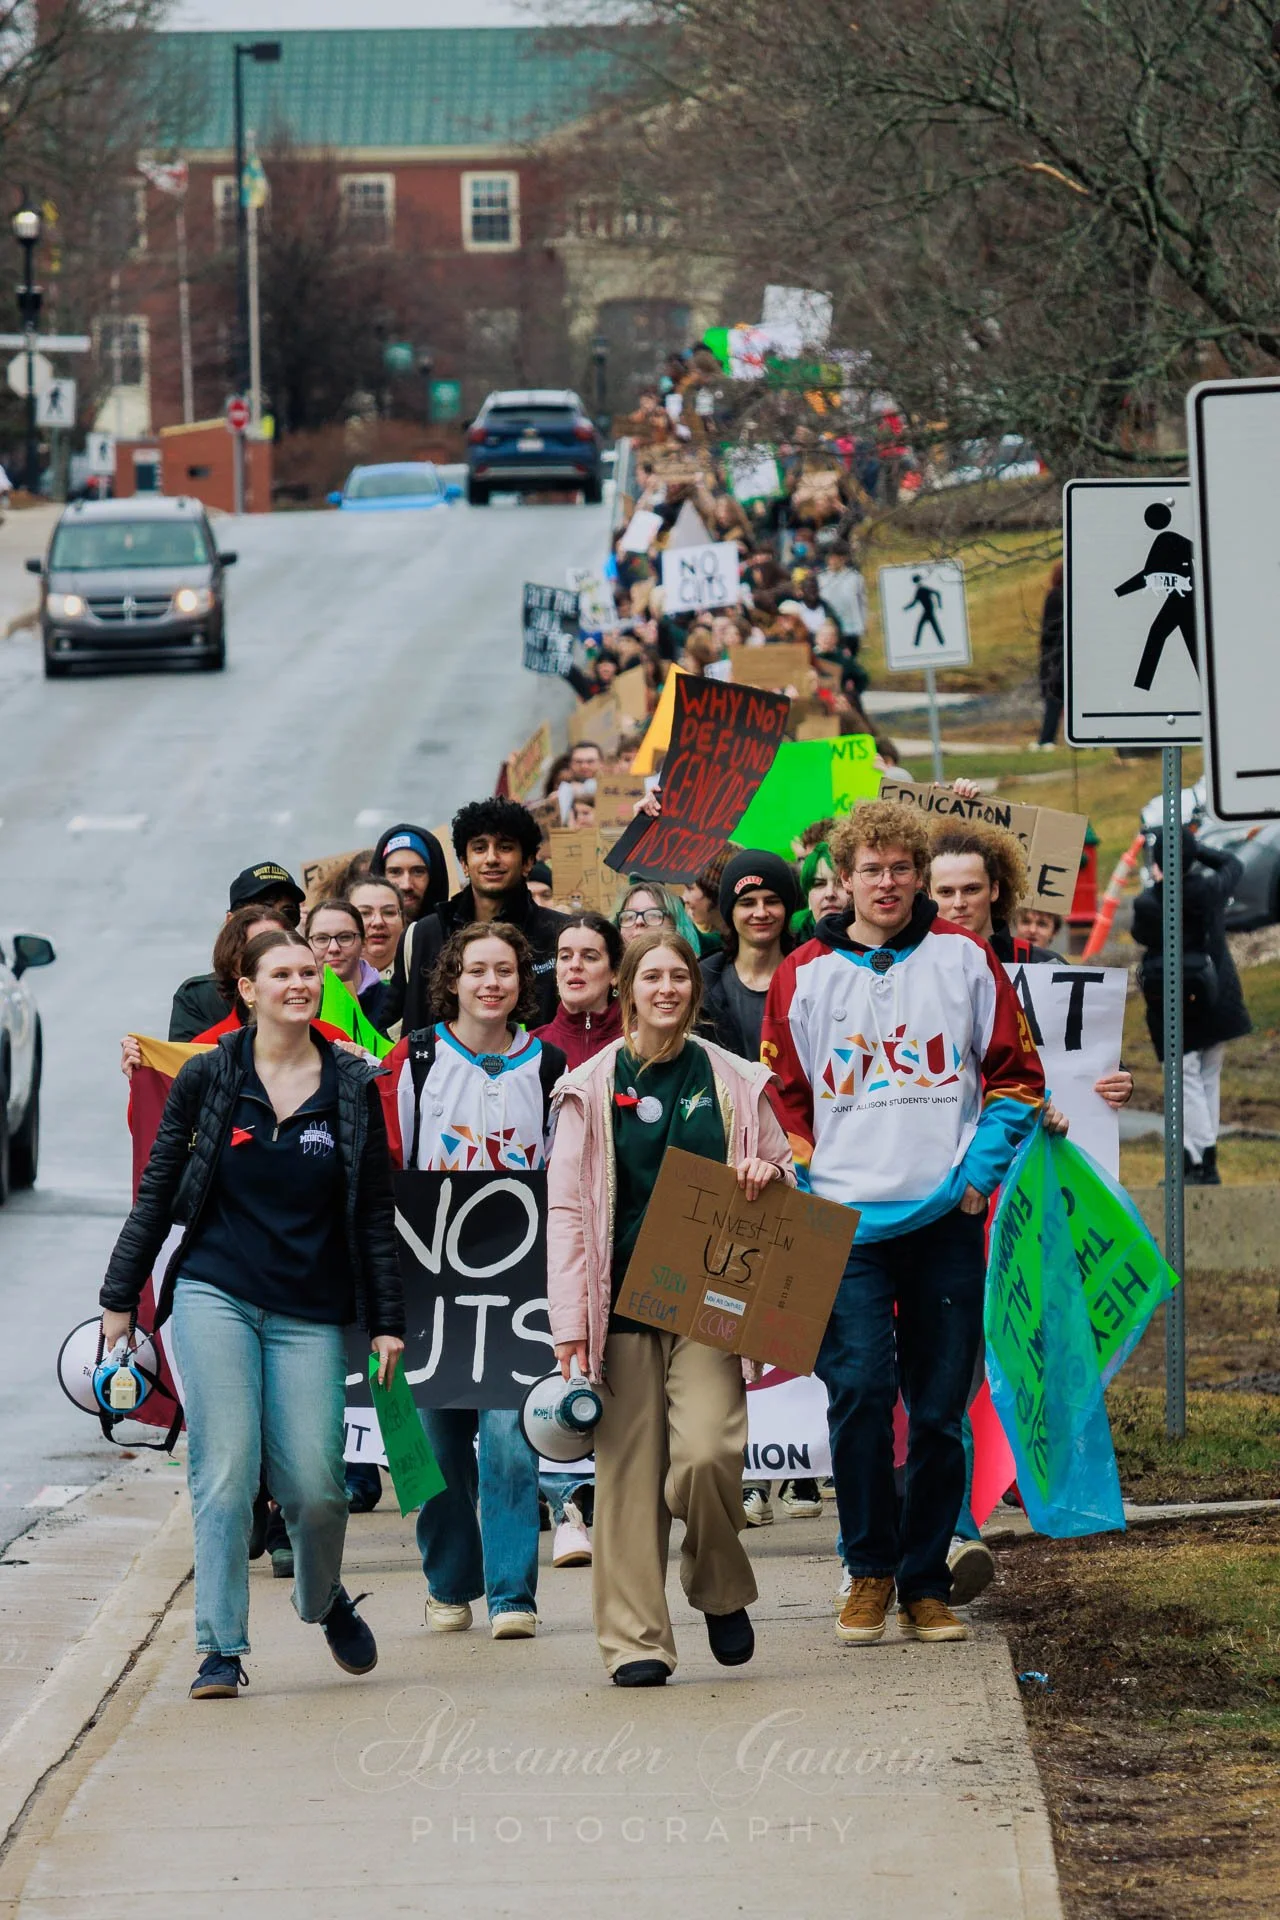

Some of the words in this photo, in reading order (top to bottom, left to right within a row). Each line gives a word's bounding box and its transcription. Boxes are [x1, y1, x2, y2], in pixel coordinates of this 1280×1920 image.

[679, 550, 718, 577] NO
[679, 679, 743, 729] WHY
[746, 695, 789, 737] NOT
[679, 716, 775, 774] DEFUND
[881, 785, 1011, 829] EDUCATION
[856, 1101, 887, 1111] ALLISON
[931, 1096, 958, 1104] UNION
[300, 1134, 335, 1148] MONCTON
[395, 1178, 539, 1278] NO
[768, 1217, 794, 1251] IN
[703, 1235, 760, 1284] US
[1002, 1265, 1034, 1350] ALL
[1090, 1262, 1150, 1354] HEY
[346, 1296, 562, 1385] UTS
